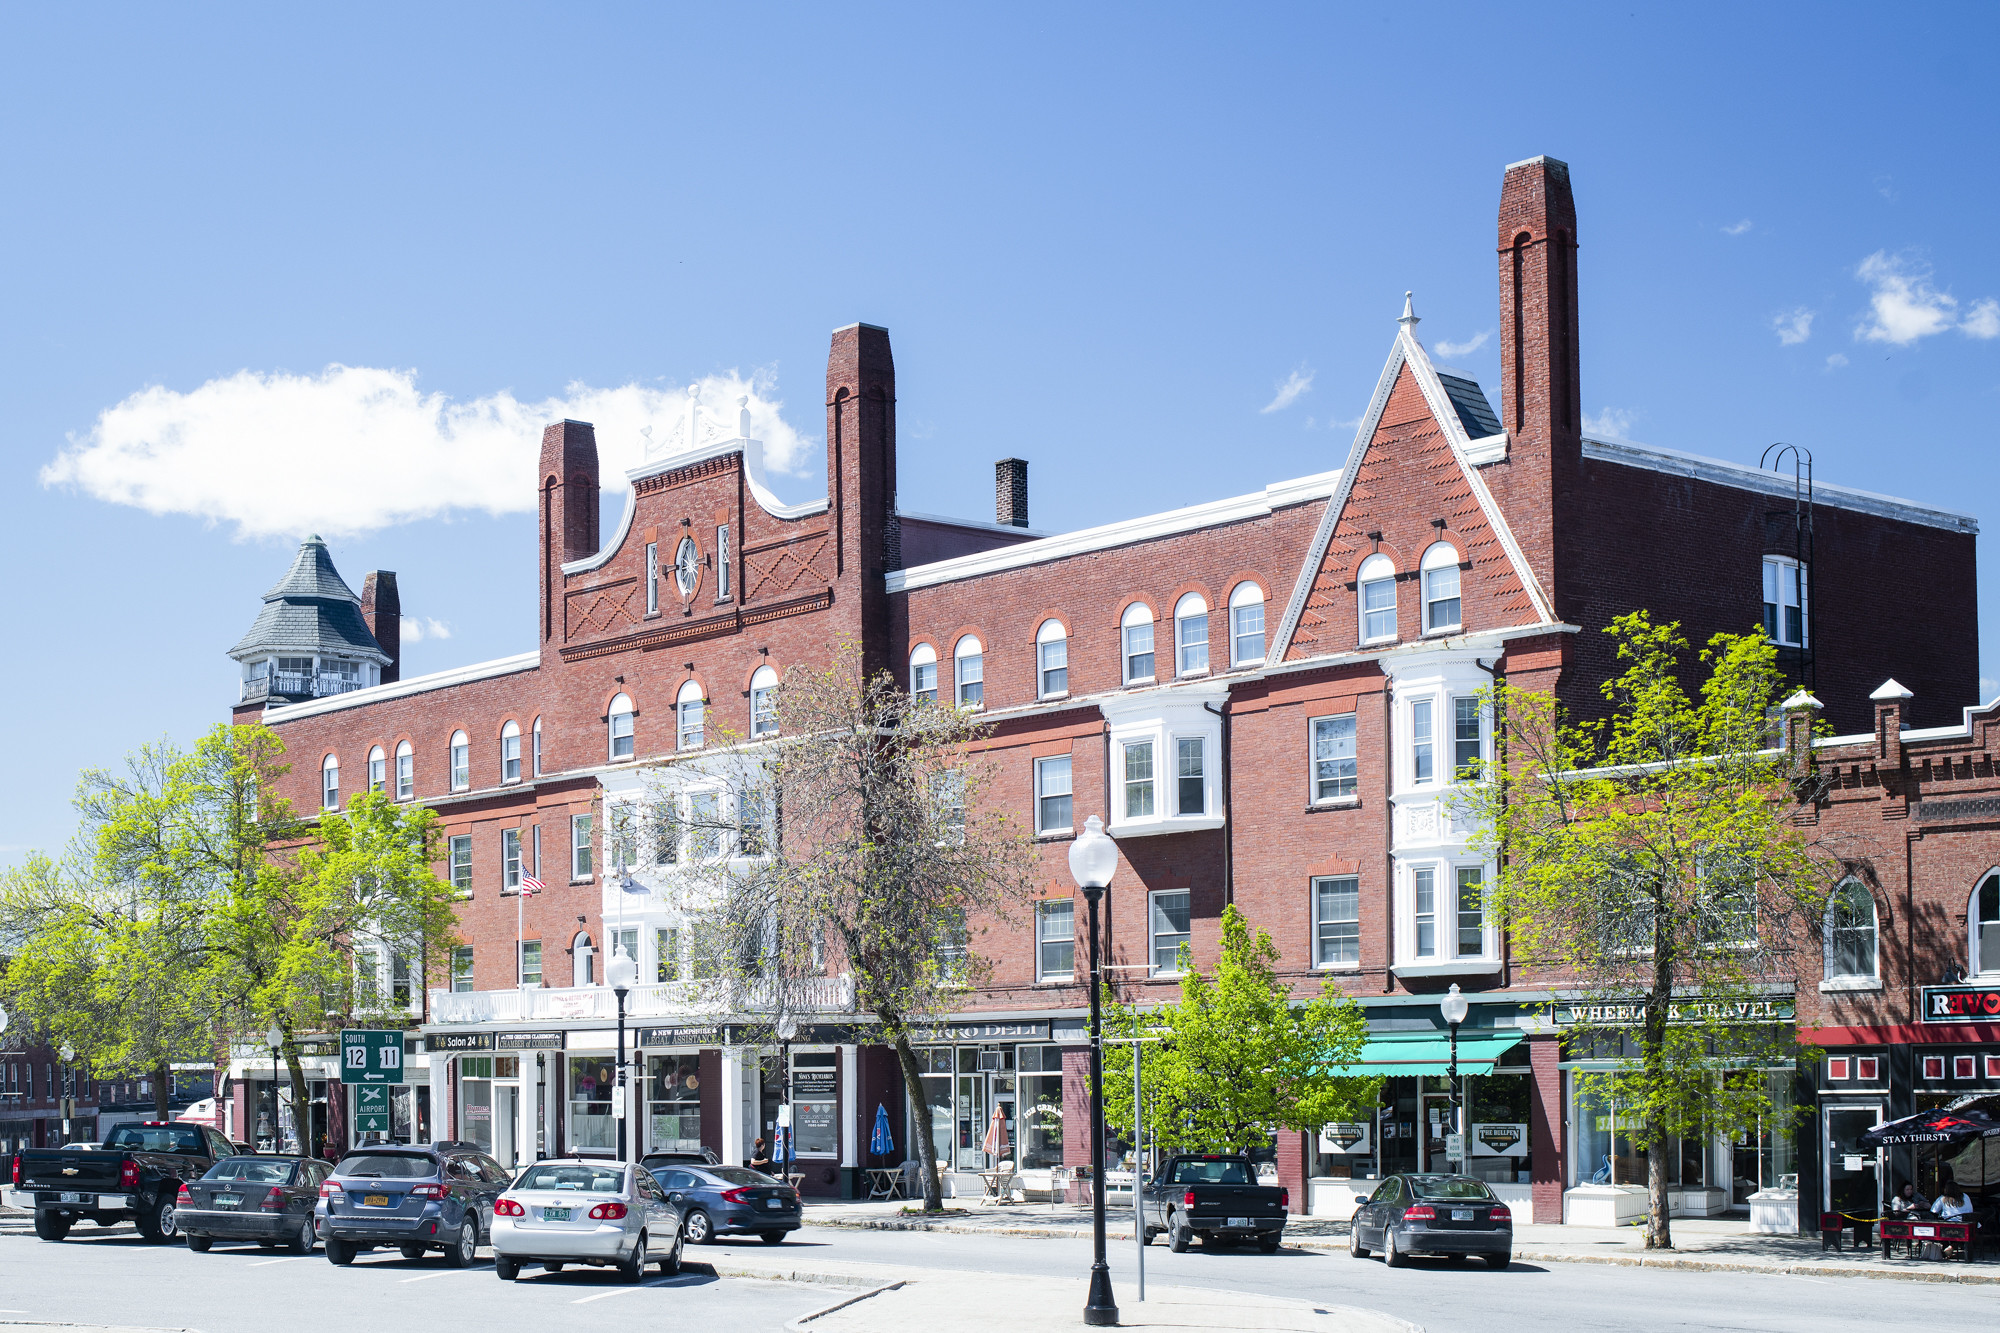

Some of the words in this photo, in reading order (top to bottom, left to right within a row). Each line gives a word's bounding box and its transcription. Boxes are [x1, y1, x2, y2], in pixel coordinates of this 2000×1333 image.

[1569, 1005, 1681, 1020] WHEELK
[1693, 1002, 1777, 1018] TRAVEL
[985, 1024, 1037, 1036] DELI
[345, 1034, 366, 1043] SOUTH
[385, 1034, 394, 1043] TO
[447, 1036, 467, 1048] Salon
[467, 1036, 476, 1047] 24
[500, 1039, 525, 1048] CHAMBER
[532, 1039, 561, 1047] COMMERCE
[646, 1035, 670, 1045] LEGAL
[350, 1049, 364, 1066] 12
[385, 1049, 396, 1066] 11
[360, 1104, 385, 1113] AIRPORT
[1023, 1106, 1037, 1119] ICE
[1338, 1128, 1363, 1138] BULLPEN
[1480, 1129, 1493, 1139] THE
[1493, 1129, 1519, 1139] BULLPEN
[1883, 1135, 1907, 1144] STAY
[1909, 1133, 1951, 1142] THIRSTY
